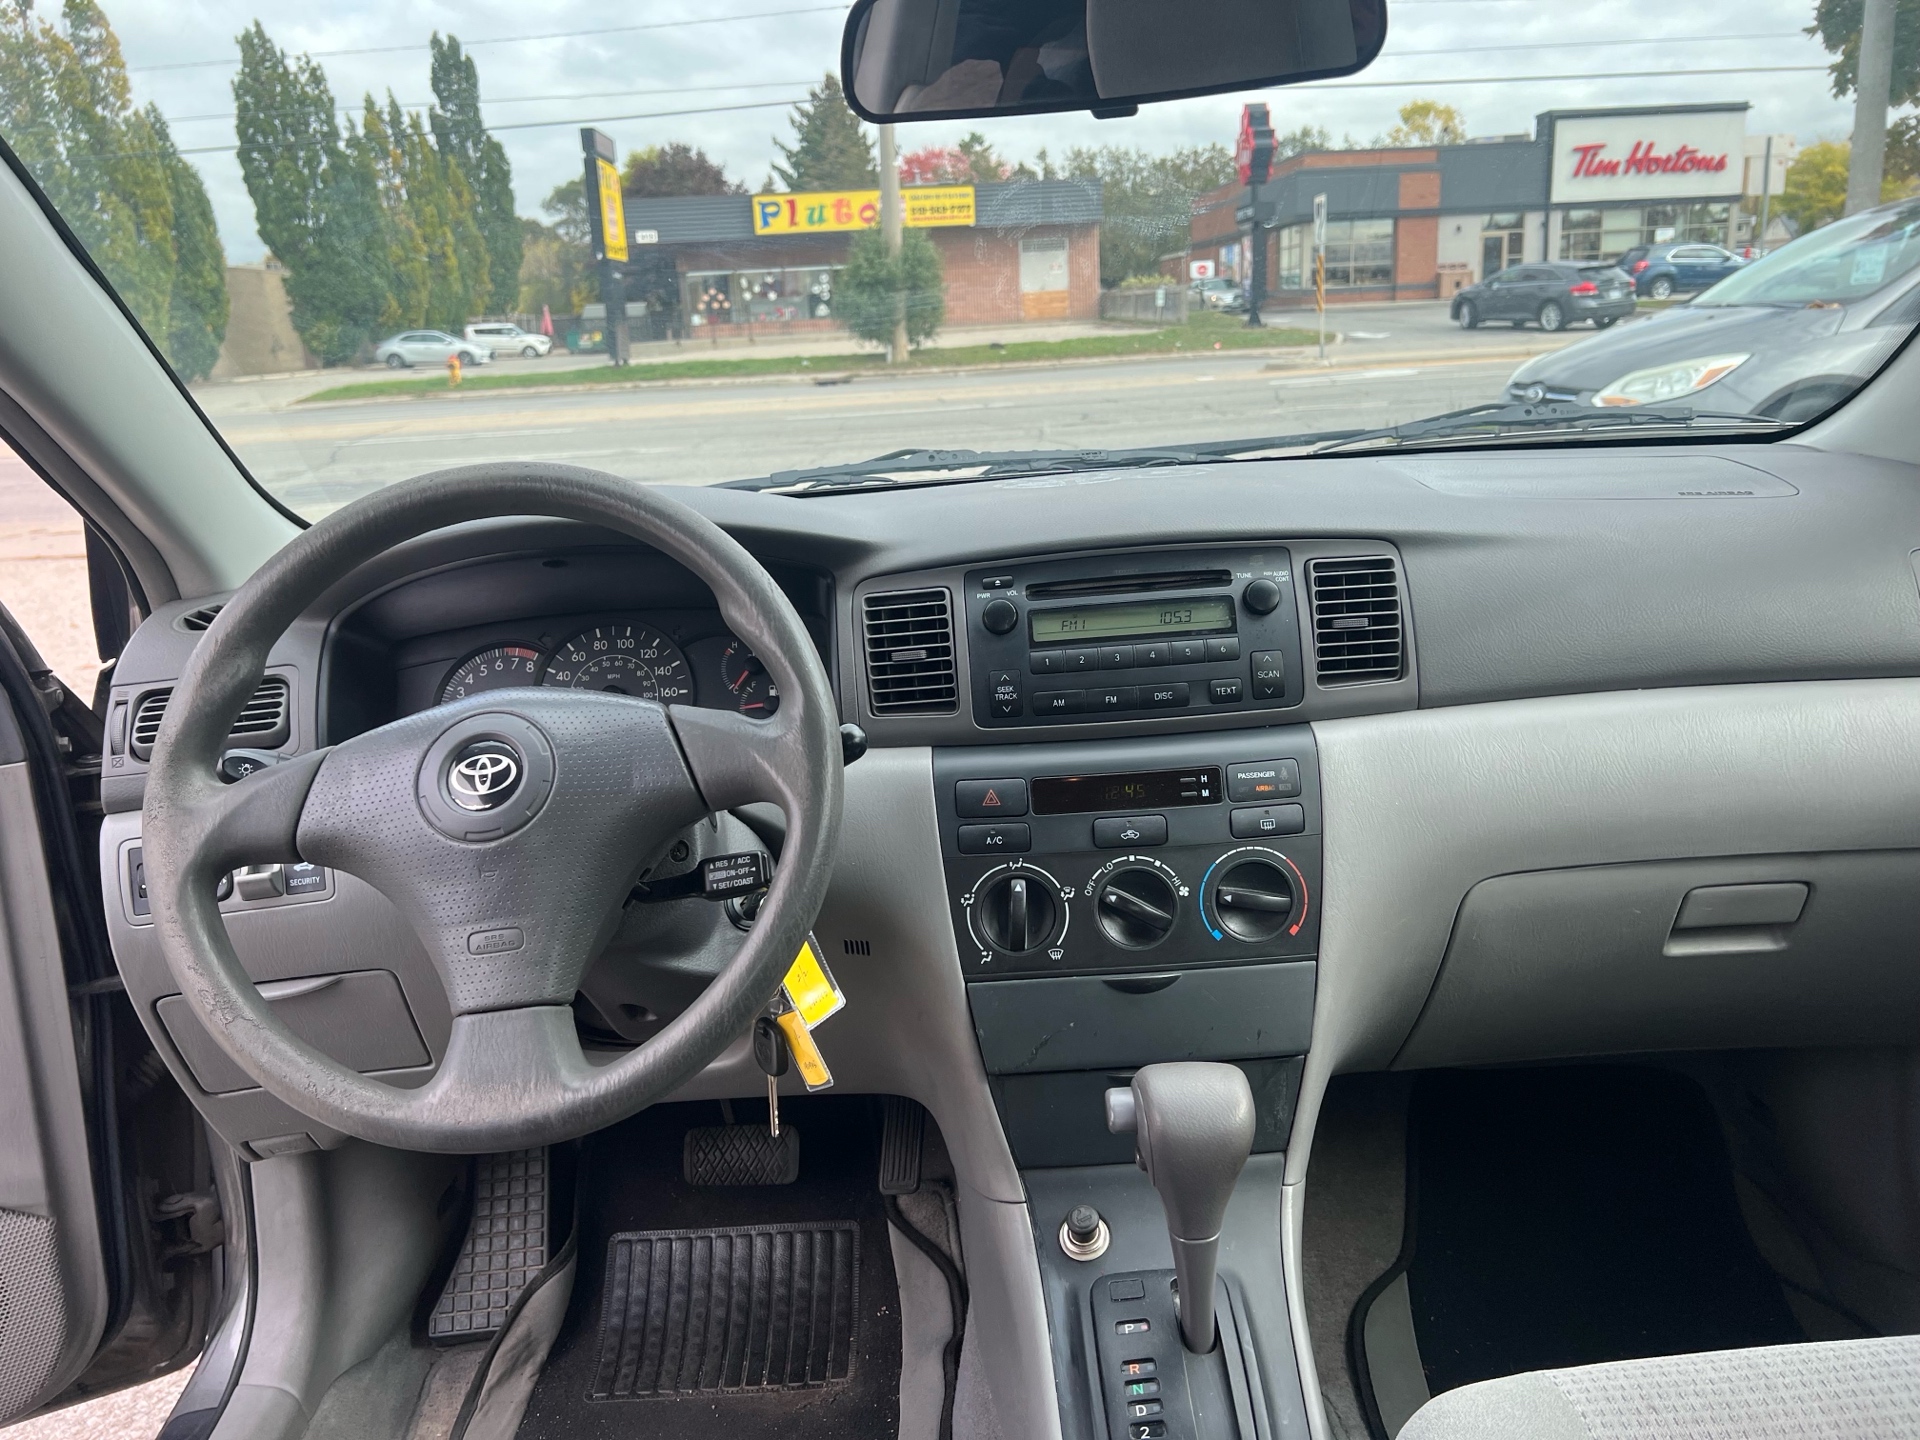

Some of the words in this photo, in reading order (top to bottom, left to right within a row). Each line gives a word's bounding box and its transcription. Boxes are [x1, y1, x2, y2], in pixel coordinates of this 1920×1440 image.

[1573, 142, 1621, 178] Tim
[1623, 139, 1728, 176] Hortons
[593, 639, 608, 650] 80
[617, 638, 635, 649] 100
[732, 641, 738, 649] H
[640, 648, 658, 660] 120
[1185, 648, 1192, 656] 5
[1220, 645, 1227, 653] 6
[571, 652, 586, 663] 60
[1079, 656, 1086, 664] 2
[1114, 654, 1121, 662] 3
[1150, 651, 1156, 659] 4
[495, 658, 503, 671] 6
[510, 658, 519, 670] 7
[526, 660, 535, 673] 8
[614, 659, 624, 667] 60
[627, 661, 635, 669] 70
[1045, 658, 1050, 666] 1
[480, 664, 488, 676] 5
[636, 669, 645, 677] 80
[654, 665, 672, 677] 140
[1257, 670, 1281, 679] SCAN
[465, 673, 474, 685] 4
[555, 670, 571, 681] 40
[581, 674, 590, 682] 30
[752, 681, 757, 689] F
[997, 686, 1014, 694] SEEK
[456, 686, 465, 698] 3
[660, 686, 678, 697] 160
[1154, 691, 1174, 701] DISC
[1216, 686, 1237, 696] TEXT
[995, 692, 1018, 701] TRACK
[1105, 696, 1118, 705] FM
[1053, 699, 1066, 708] AM
[1200, 774, 1208, 783] H
[1237, 770, 1276, 779] PASSENGER
[1201, 789, 1210, 797] M
[1255, 784, 1276, 792] AIRBAG
[986, 836, 1003, 846] A/C
[715, 859, 728, 868] RES
[737, 856, 751, 865] ACC
[1101, 861, 1114, 874] LO
[289, 876, 321, 886] SECURITY
[718, 876, 754, 890] SET/COAST
[1171, 876, 1181, 888] HI
[1083, 878, 1096, 897] OFF
[476, 940, 515, 951] AIRBAG
[1124, 1323, 1134, 1334] P
[1129, 1364, 1140, 1374] R
[1132, 1384, 1143, 1394] N
[1135, 1405, 1147, 1416] D
[1139, 1426, 1150, 1439] 2
